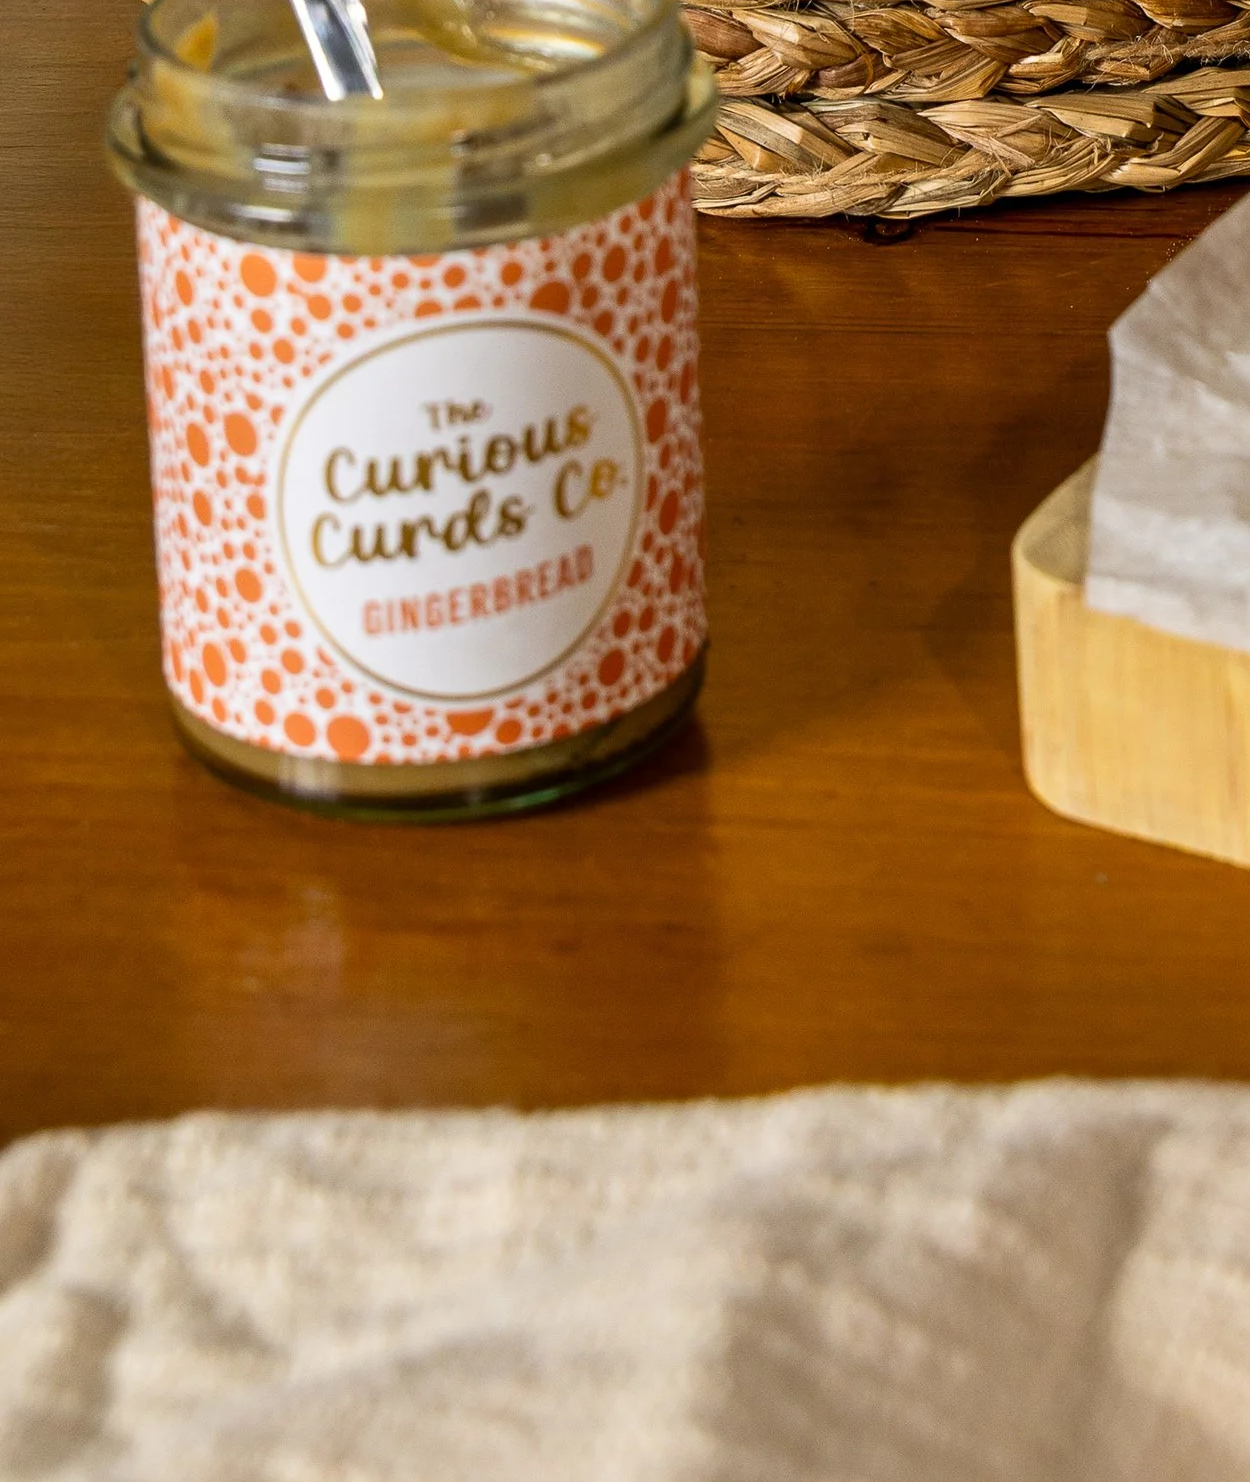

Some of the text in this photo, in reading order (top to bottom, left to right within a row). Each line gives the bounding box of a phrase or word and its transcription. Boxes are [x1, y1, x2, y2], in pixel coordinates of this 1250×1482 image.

[322, 403, 597, 505] Curious
[422, 396, 493, 432] The
[310, 456, 630, 569] Curds Co.
[361, 541, 595, 637] GINGERBREAD
